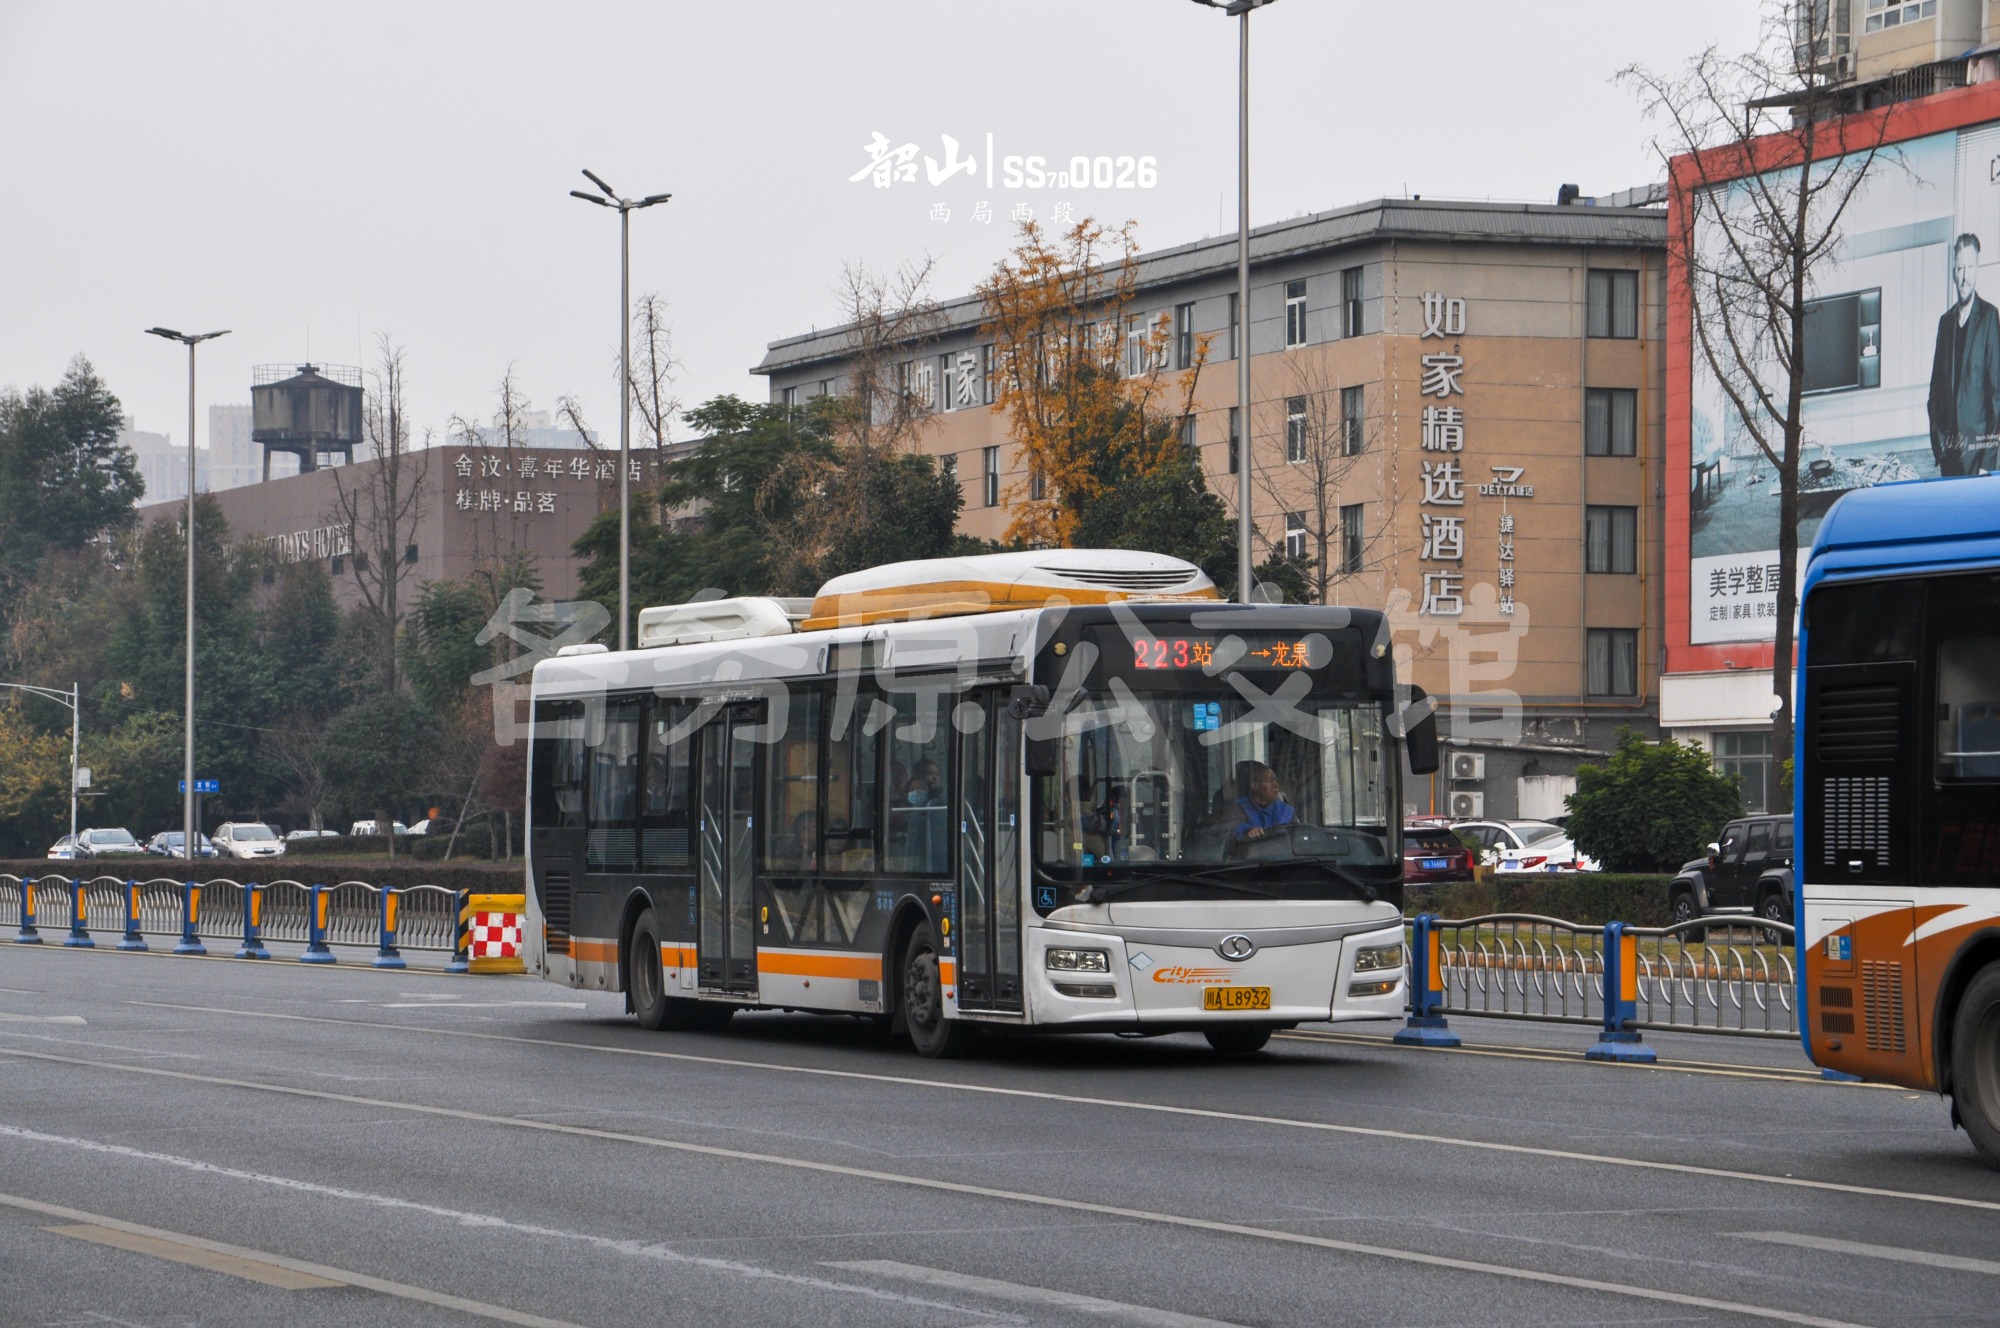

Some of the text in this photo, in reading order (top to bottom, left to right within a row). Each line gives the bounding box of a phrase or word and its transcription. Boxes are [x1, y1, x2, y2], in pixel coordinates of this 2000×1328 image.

[1420, 291, 1466, 616] 如家精选酒店
[1499, 513, 1515, 614] 捷达驿站
[1710, 564, 1780, 598] 美学整屋
[1135, 640, 1189, 668] 223
[1271, 641, 1309, 667] 龙泉
[1153, 966, 1192, 983] City
